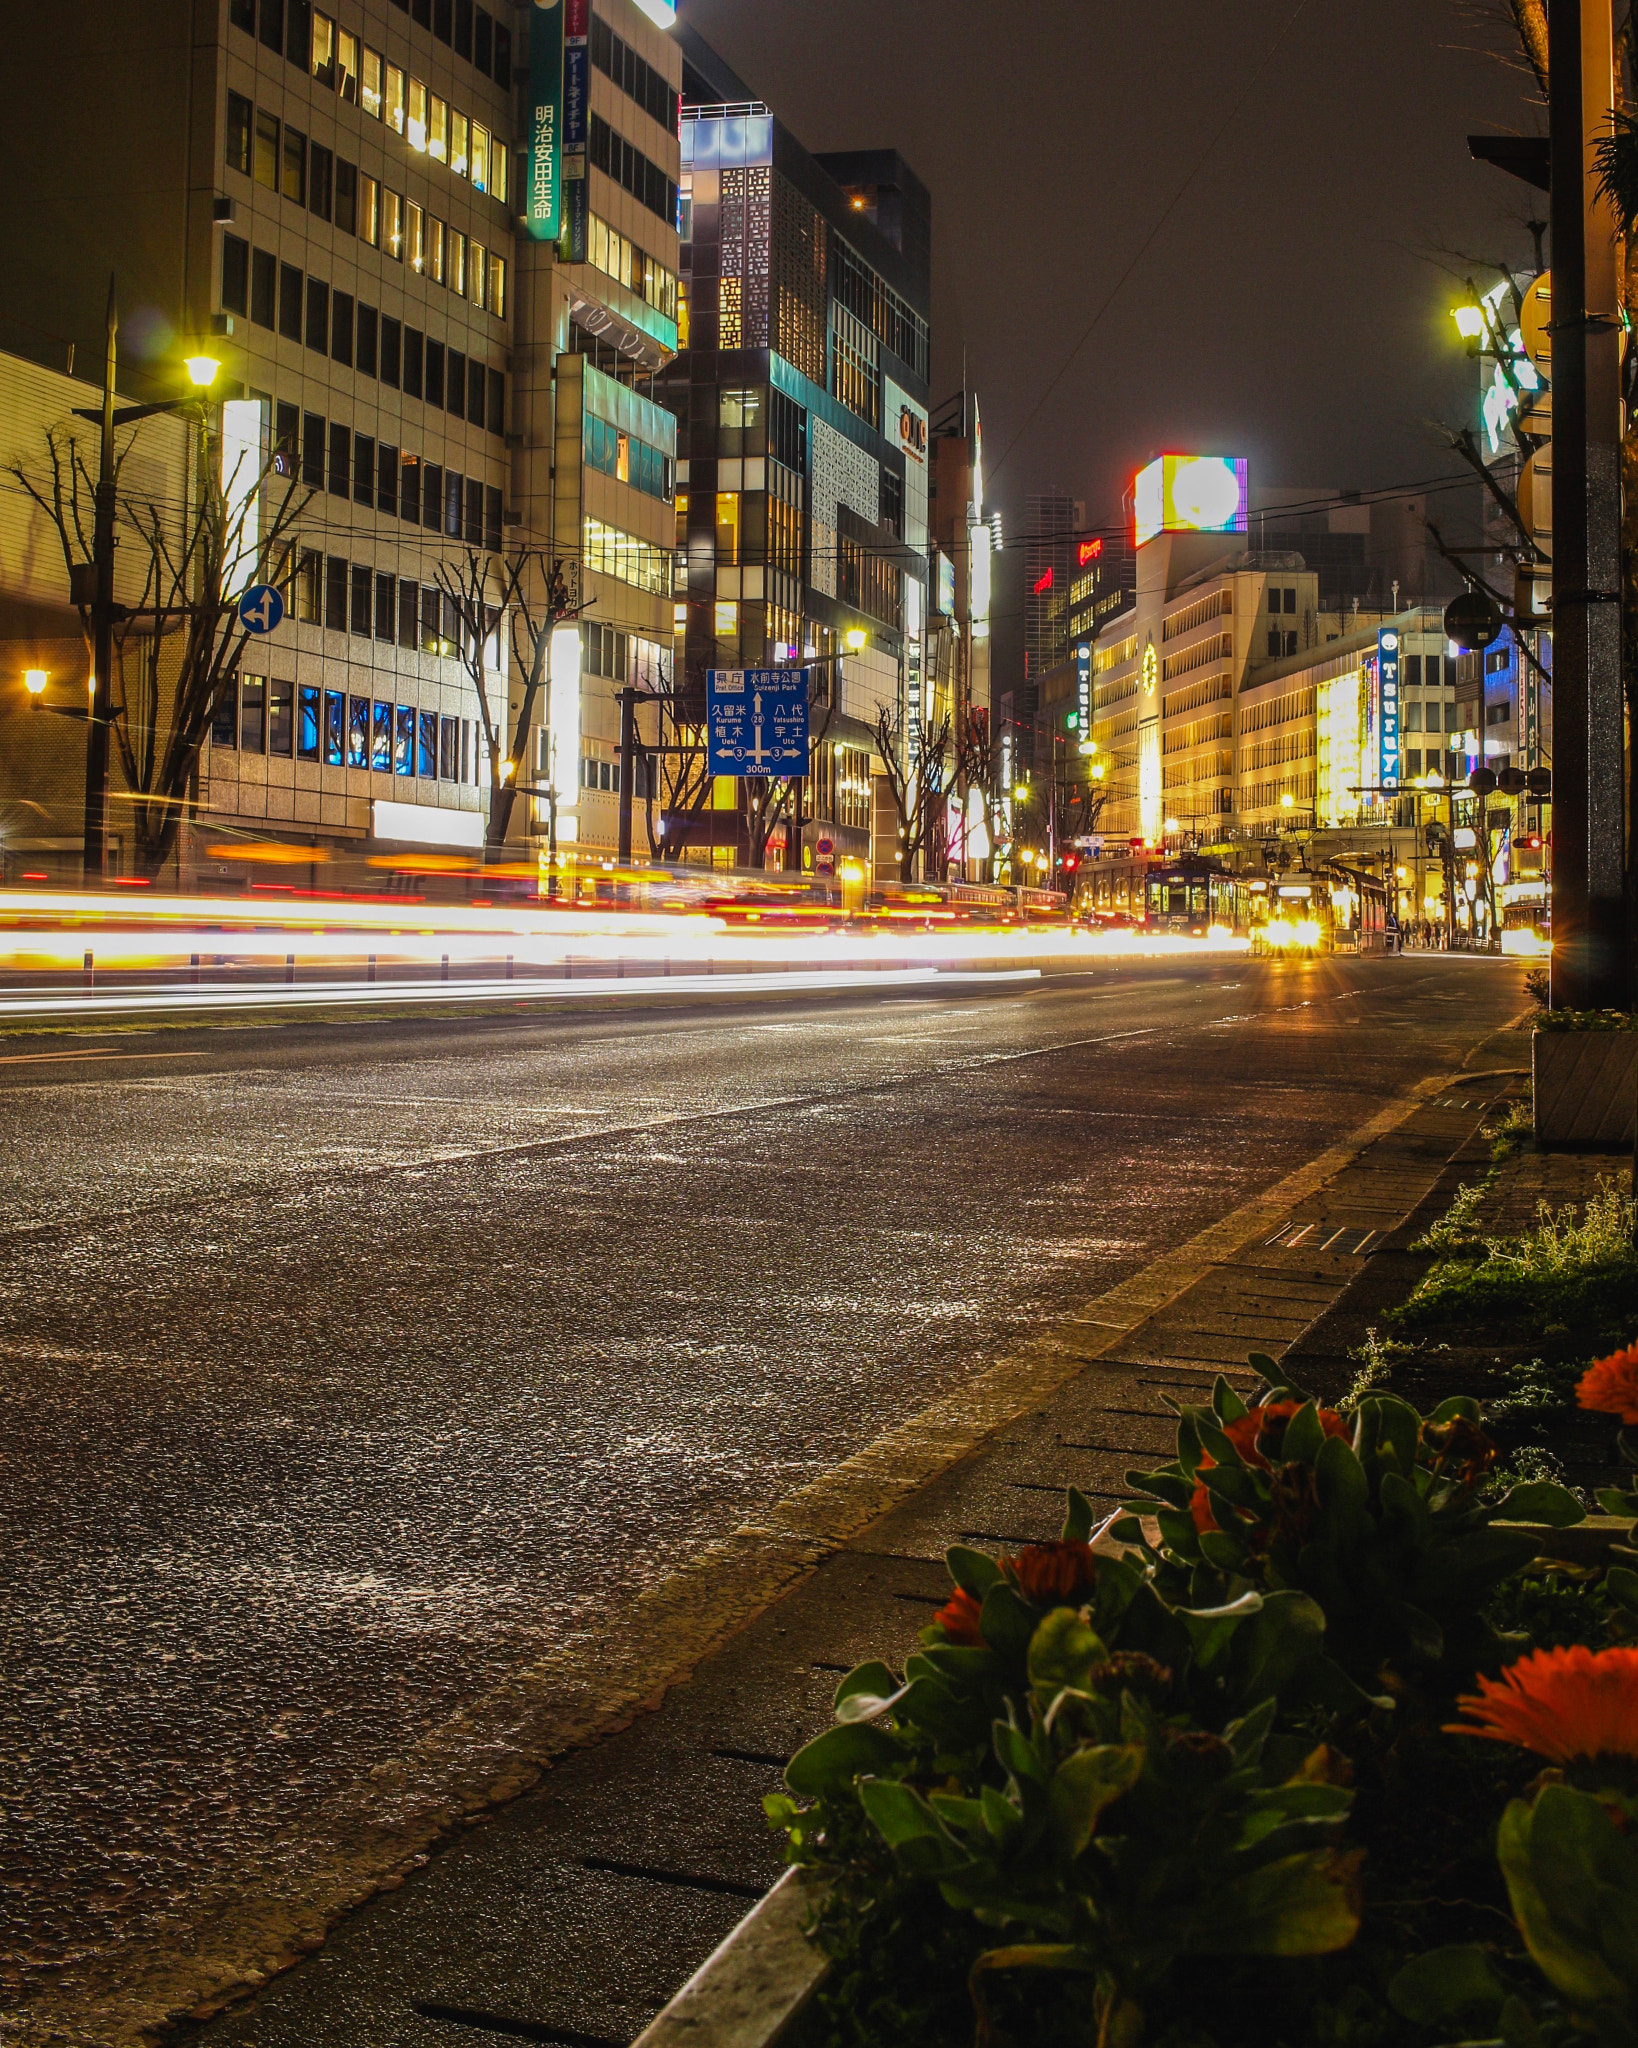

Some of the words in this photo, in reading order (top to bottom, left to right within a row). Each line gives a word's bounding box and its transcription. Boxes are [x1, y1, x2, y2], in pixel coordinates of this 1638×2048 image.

[567, 144, 579, 152] 8F
[533, 105, 554, 219] 明治安田生命
[568, 561, 578, 607] ホットヨガ
[716, 672, 744, 684] 県庁
[750, 671, 801, 684] 水前寺公園
[711, 704, 746, 716] 久留米
[774, 704, 803, 716] 八代
[1382, 662, 1397, 788] Tsuruya
[714, 726, 744, 738] 植木
[774, 726, 803, 738] 宇土
[736, 748, 743, 757] 3
[774, 748, 780, 757] 3
[745, 765, 771, 773] 300m
